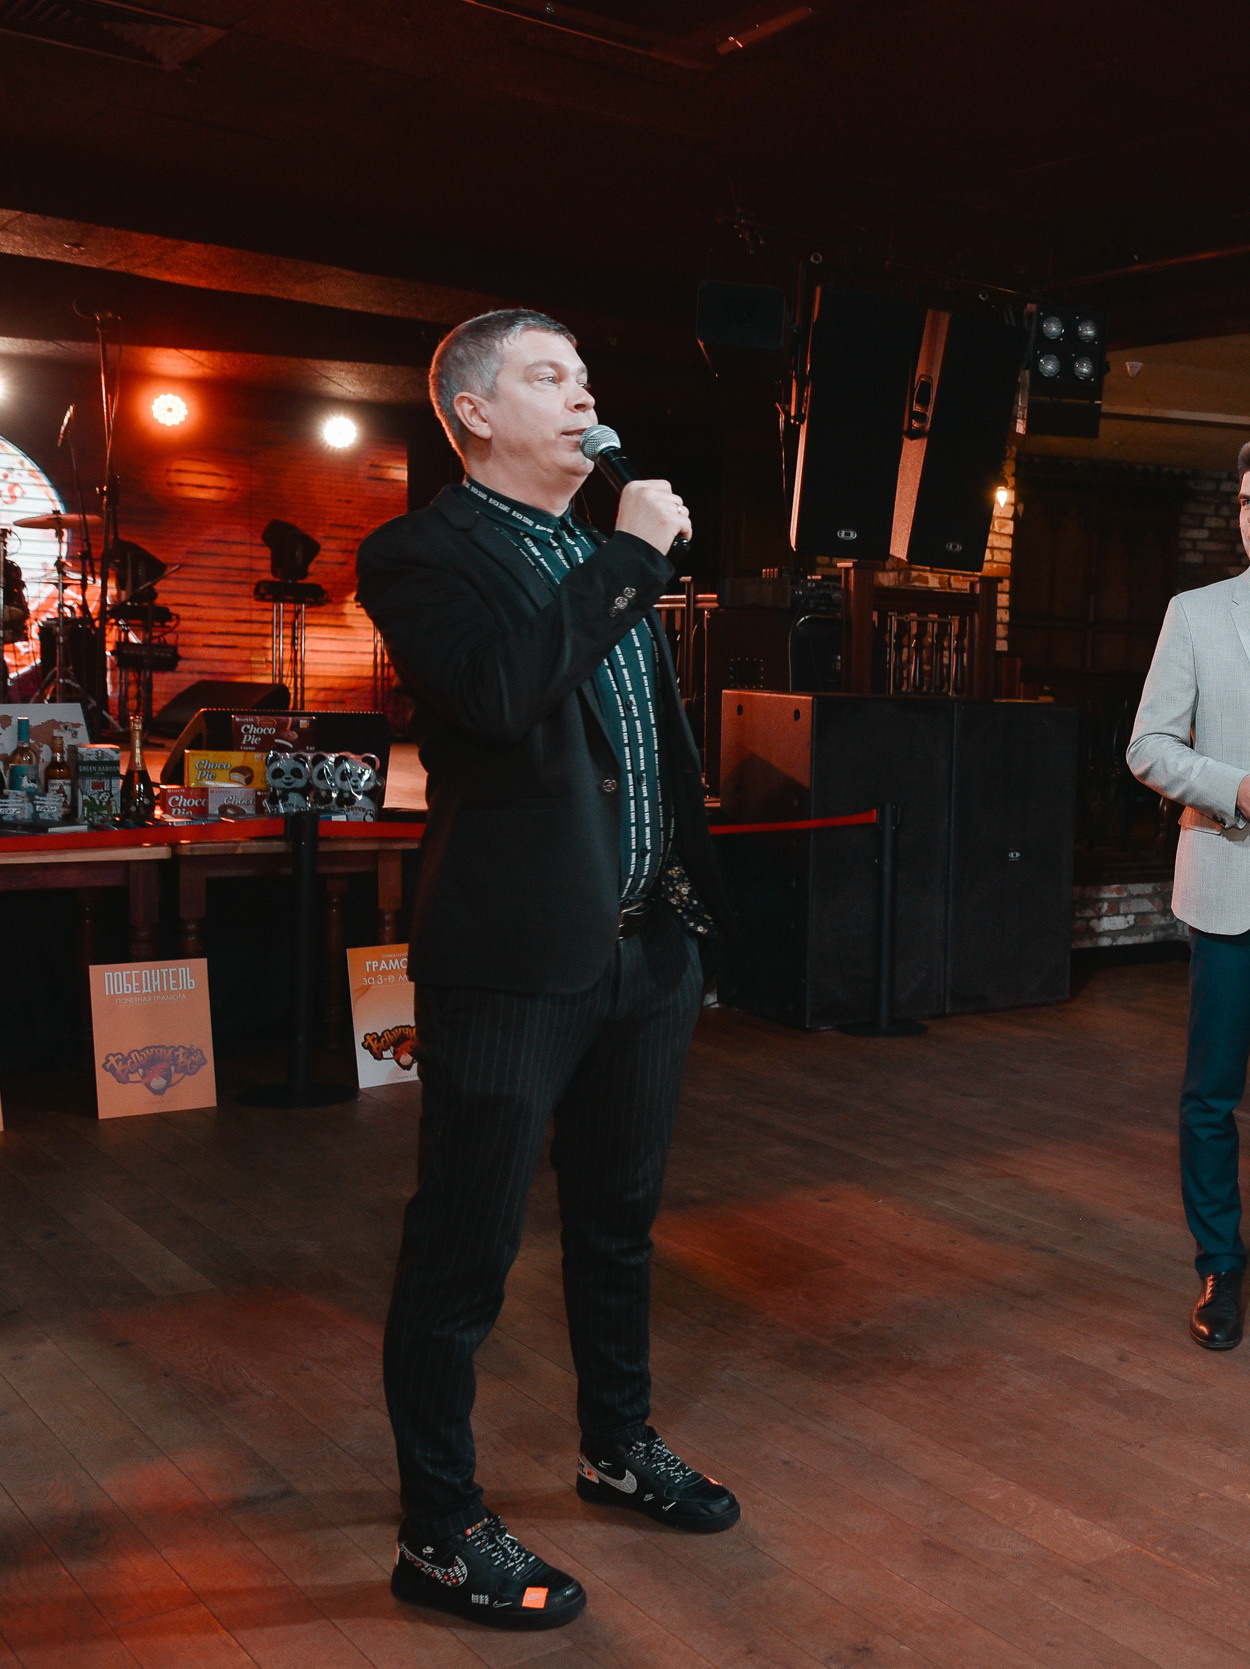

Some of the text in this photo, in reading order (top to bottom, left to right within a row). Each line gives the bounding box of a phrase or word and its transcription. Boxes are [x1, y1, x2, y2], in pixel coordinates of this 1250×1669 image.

[240, 724, 276, 735] Choco
[241, 734, 261, 745] Pie
[195, 760, 231, 770] Choco
[196, 770, 216, 780] Pie
[104, 967, 196, 995] ПОБЕДИТЕЛЬ
[362, 977, 375, 986] за
